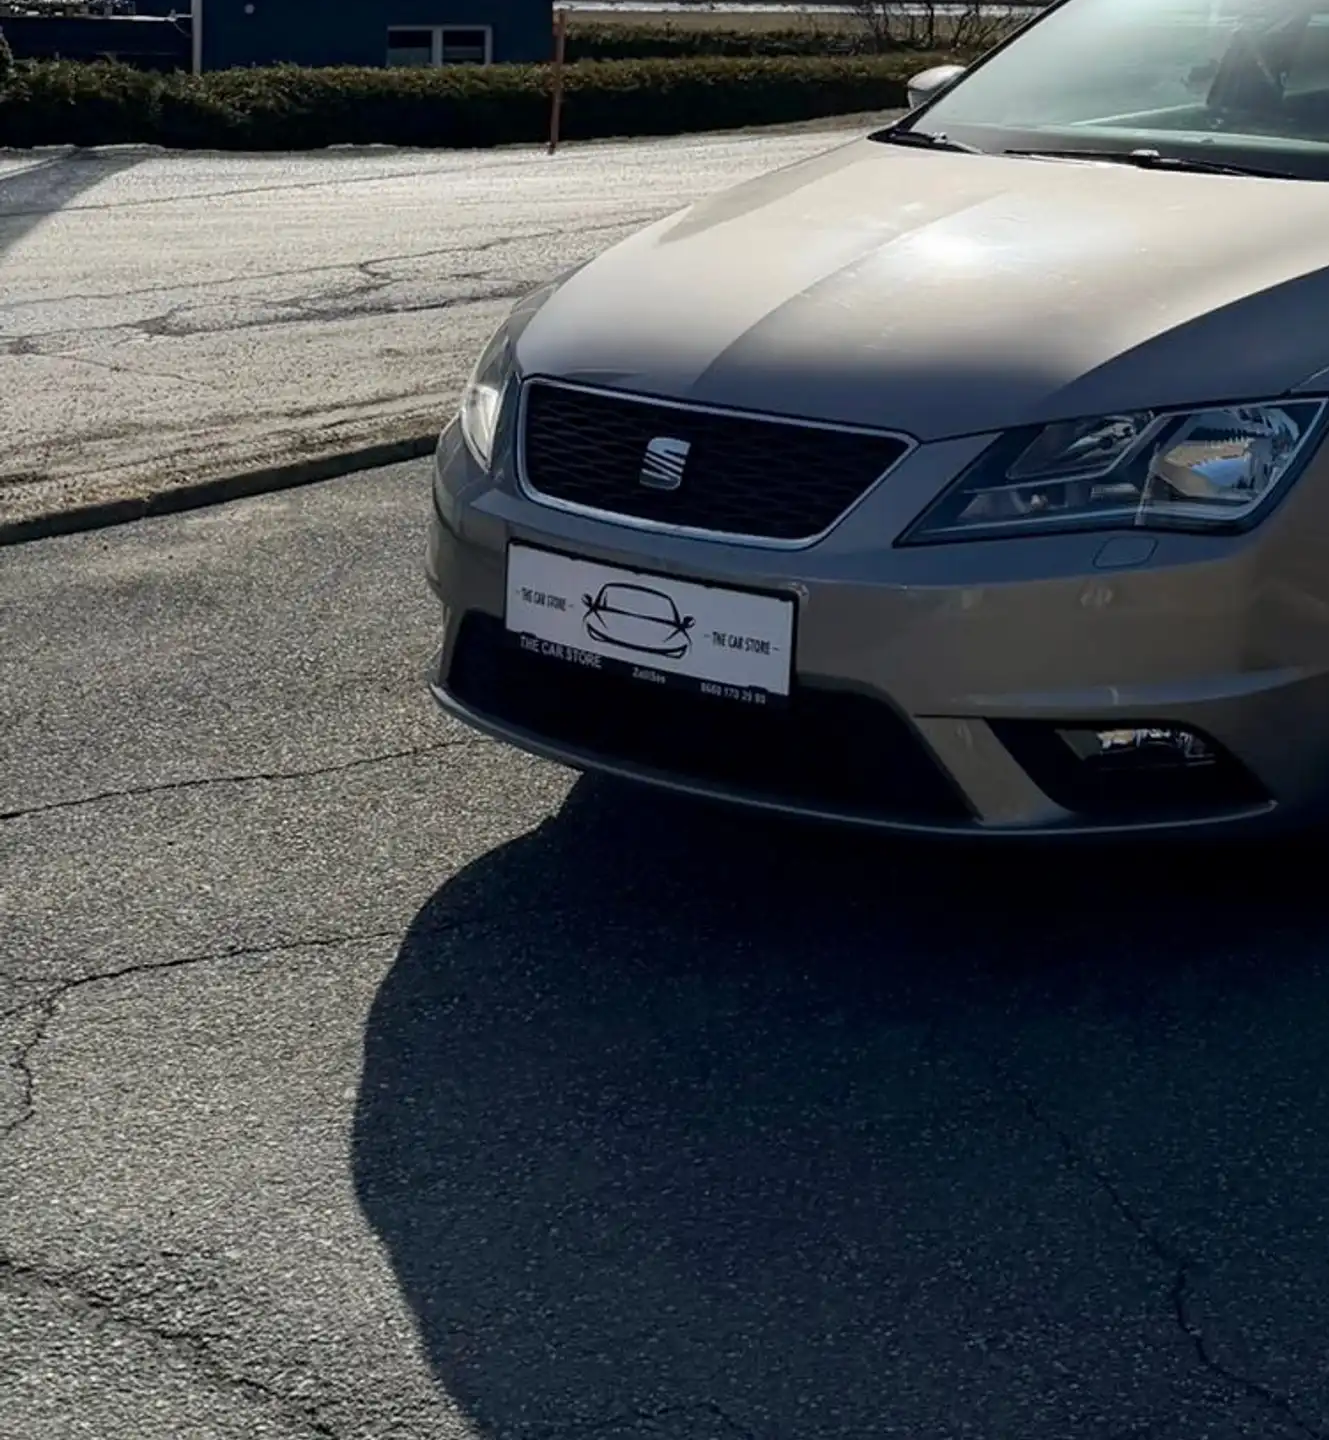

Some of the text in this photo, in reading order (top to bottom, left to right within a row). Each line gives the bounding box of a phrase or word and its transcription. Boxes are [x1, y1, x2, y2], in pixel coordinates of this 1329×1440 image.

[520, 636, 603, 670] THE CAR STORE
[712, 631, 771, 656] THE CAR STORE
